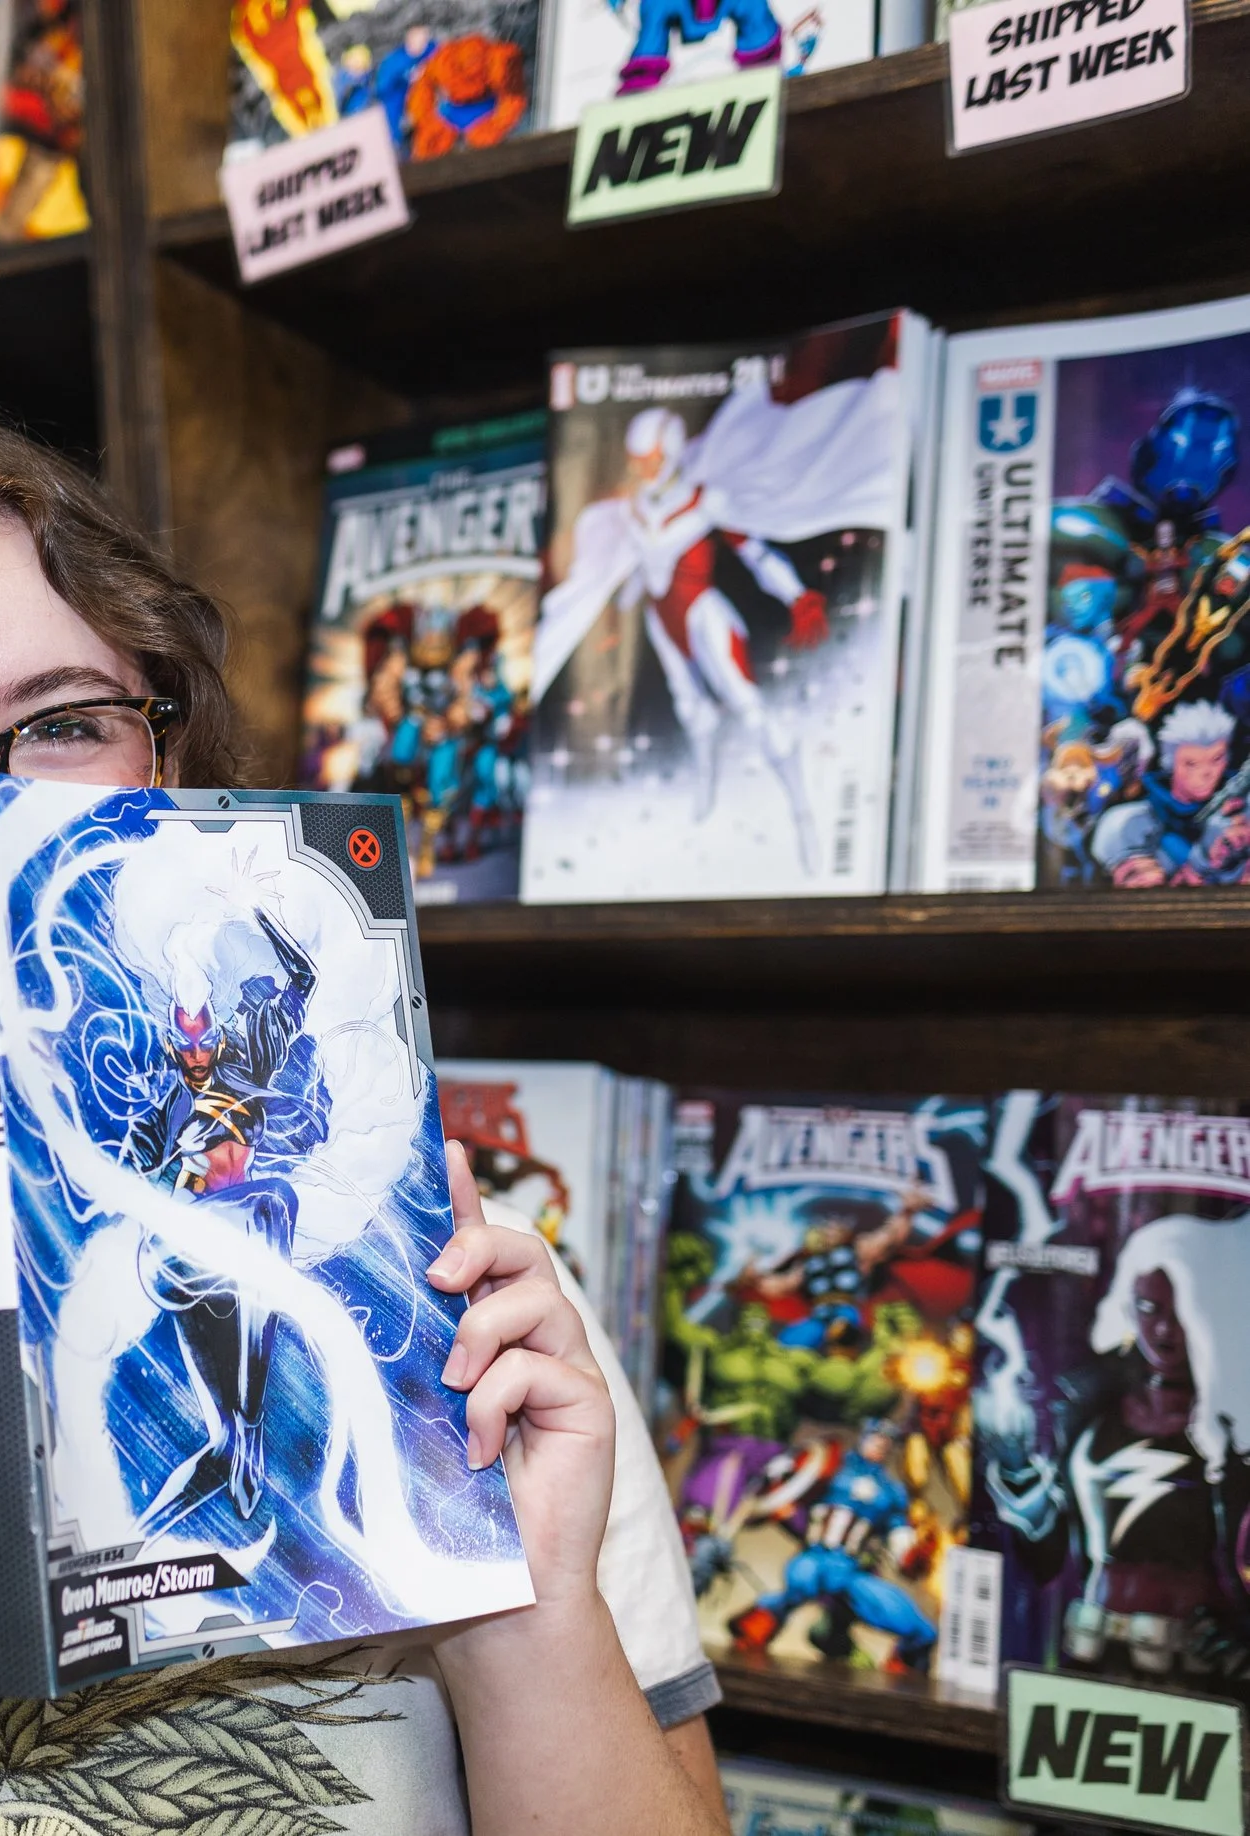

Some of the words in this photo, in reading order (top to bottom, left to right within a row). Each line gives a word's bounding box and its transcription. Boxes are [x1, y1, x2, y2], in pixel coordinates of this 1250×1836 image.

[964, 55, 1060, 109] LAST
[1069, 25, 1178, 85] WEEK
[987, 0, 1146, 55] SHIPPED
[581, 98, 768, 196] NEW
[317, 182, 386, 230] WEEK
[321, 461, 547, 620] AVENGER
[994, 462, 1035, 669] ULTIMATE
[716, 1105, 959, 1213] AVENGERS
[95, 1563, 215, 1607] Munroe/Storm
[1019, 1704, 1232, 1802] NEW
